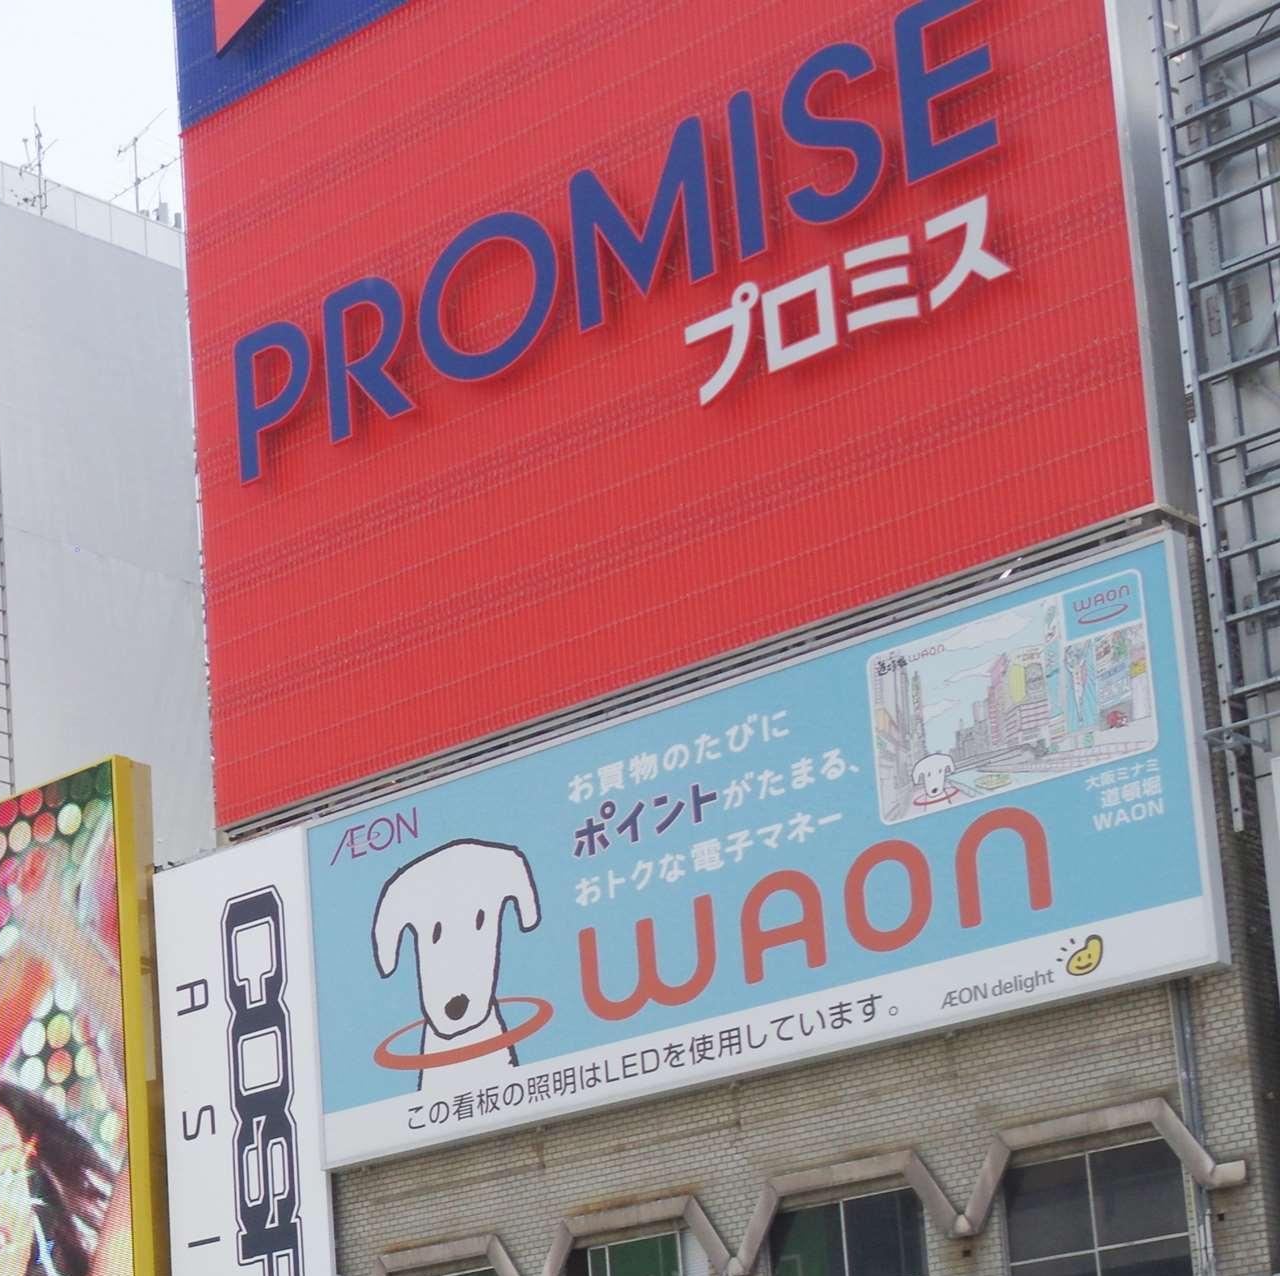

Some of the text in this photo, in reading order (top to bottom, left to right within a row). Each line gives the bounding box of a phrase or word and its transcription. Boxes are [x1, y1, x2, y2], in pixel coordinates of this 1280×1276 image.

[232, 0, 1002, 486] PROMISE
[684, 194, 1013, 406] プロミス
[567, 711, 790, 804] お買物のたびに
[1100, 774, 1164, 808] 道頓堀
[574, 811, 844, 907] おトクな電子マネー
[1092, 798, 1166, 832] WAON
[577, 807, 1055, 1022] WAON
[989, 964, 1055, 1001] delight
[406, 1000, 900, 1131] この看板の照明はLEDを使用しています。
